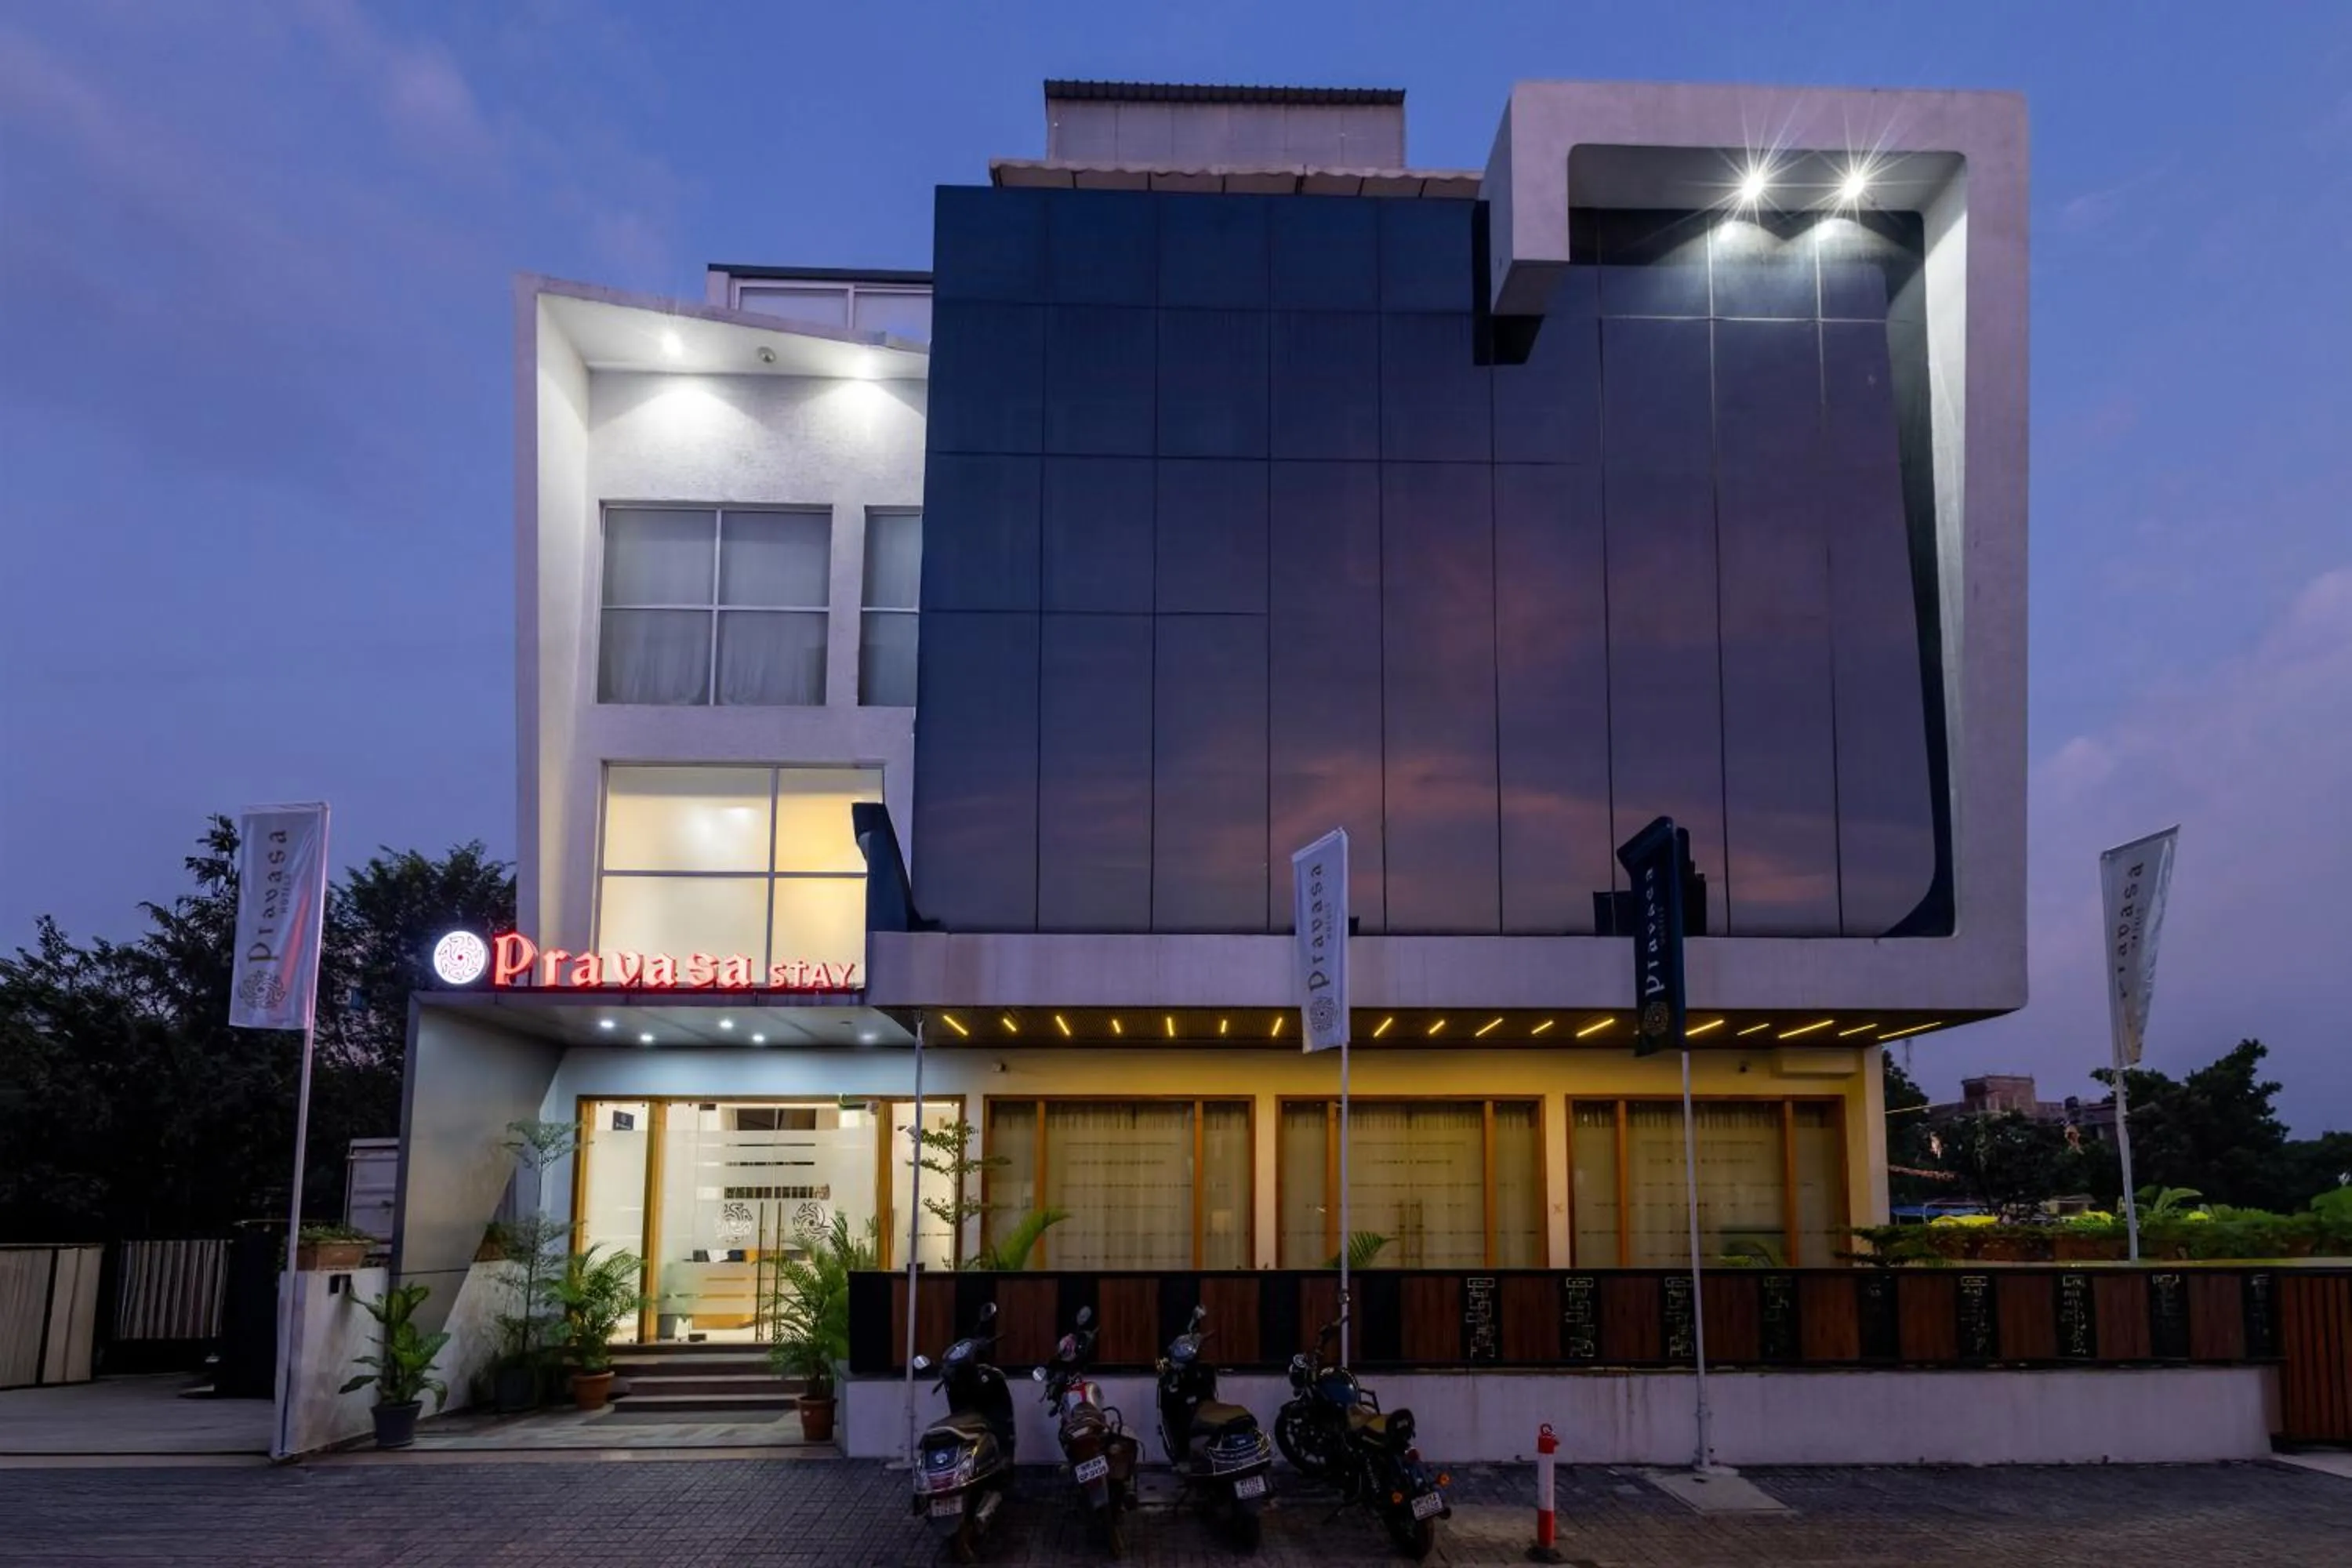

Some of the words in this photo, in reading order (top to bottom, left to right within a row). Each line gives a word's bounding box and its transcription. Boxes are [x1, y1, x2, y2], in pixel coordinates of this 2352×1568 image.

[247, 829, 287, 964] Pravasa
[493, 932, 753, 987] Pravasa
[768, 960, 856, 988] STAY
[1308, 863, 1330, 992] Pravasa
